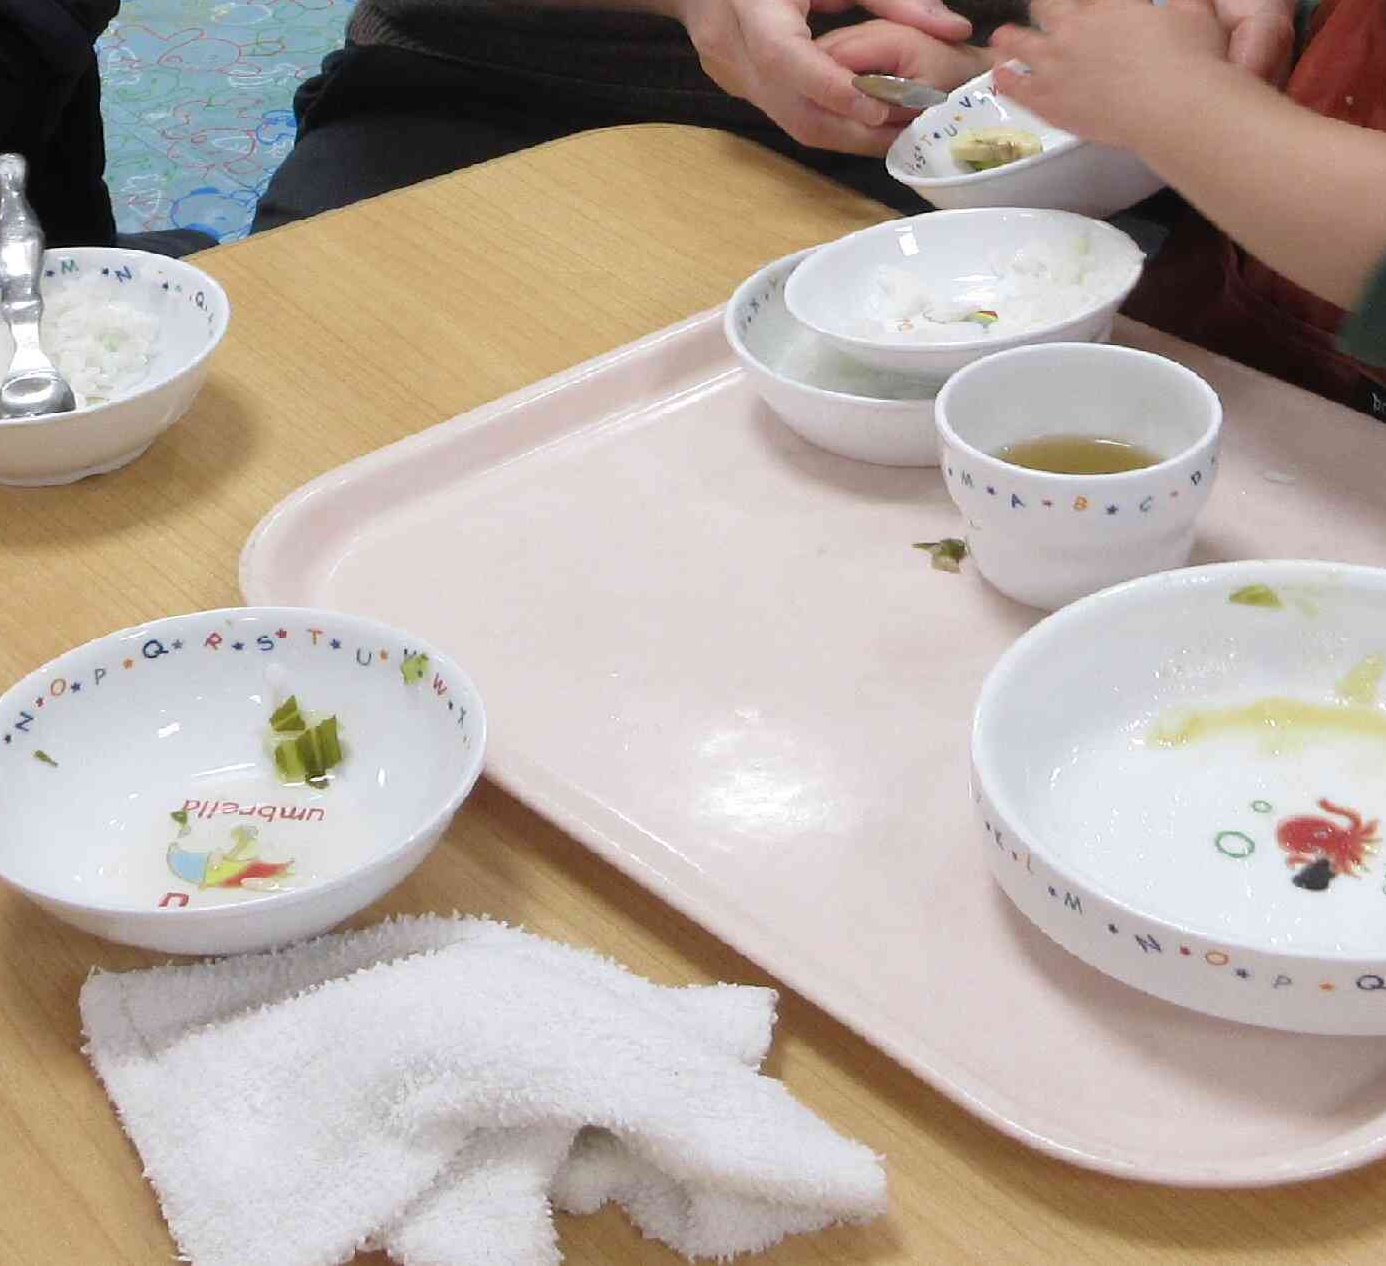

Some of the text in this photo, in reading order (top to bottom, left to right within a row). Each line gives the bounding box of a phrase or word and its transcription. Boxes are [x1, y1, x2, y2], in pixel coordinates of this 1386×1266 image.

[1011, 494, 1026, 510] A
[1073, 495, 1090, 512] B
[50, 677, 67, 697] O
[93, 667, 107, 686] P
[141, 638, 170, 659] Q
[203, 631, 223, 651] R
[256, 634, 275, 652] S
[306, 627, 324, 646] T
[355, 647, 373, 666] U
[183, 798, 327, 823] umbrella
[1205, 950, 1230, 967] O
[1271, 974, 1293, 990] P
